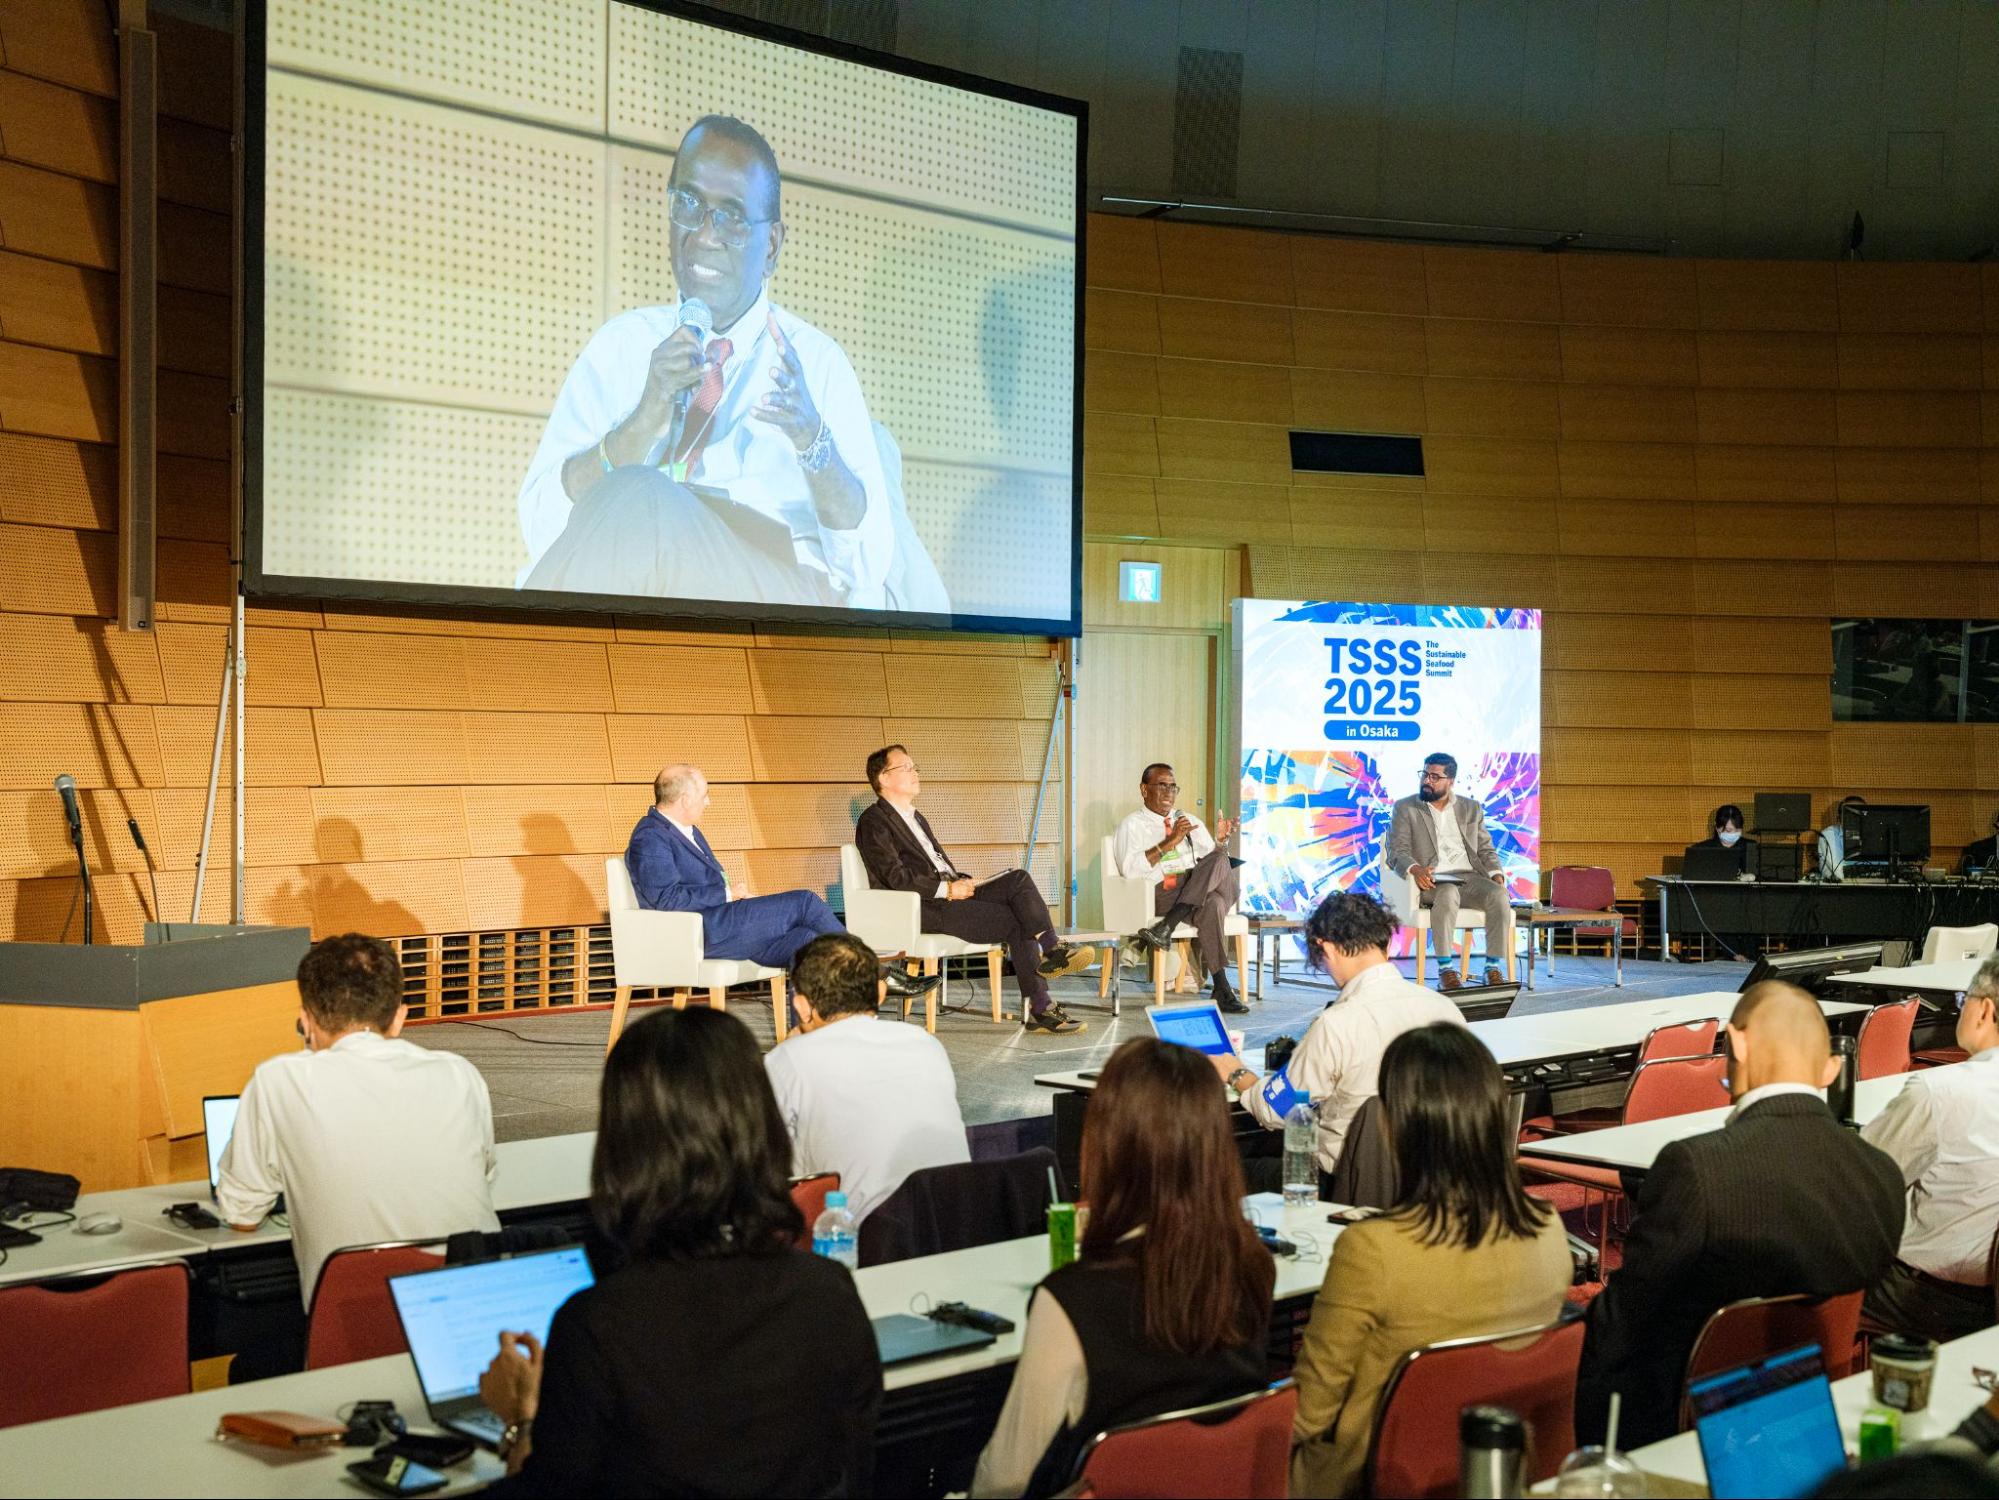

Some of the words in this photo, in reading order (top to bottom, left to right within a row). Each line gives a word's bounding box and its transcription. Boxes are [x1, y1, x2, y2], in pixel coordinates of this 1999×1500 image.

[1425, 640, 1440, 648] The
[1323, 638, 1422, 676] TSSS
[1425, 650, 1467, 659] Sustainable
[1425, 659, 1456, 668] Seafood
[1425, 669, 1453, 677] Summit
[1323, 678, 1422, 716] 2025
[1346, 725, 1357, 737] in
[1359, 724, 1399, 737] Osaka
